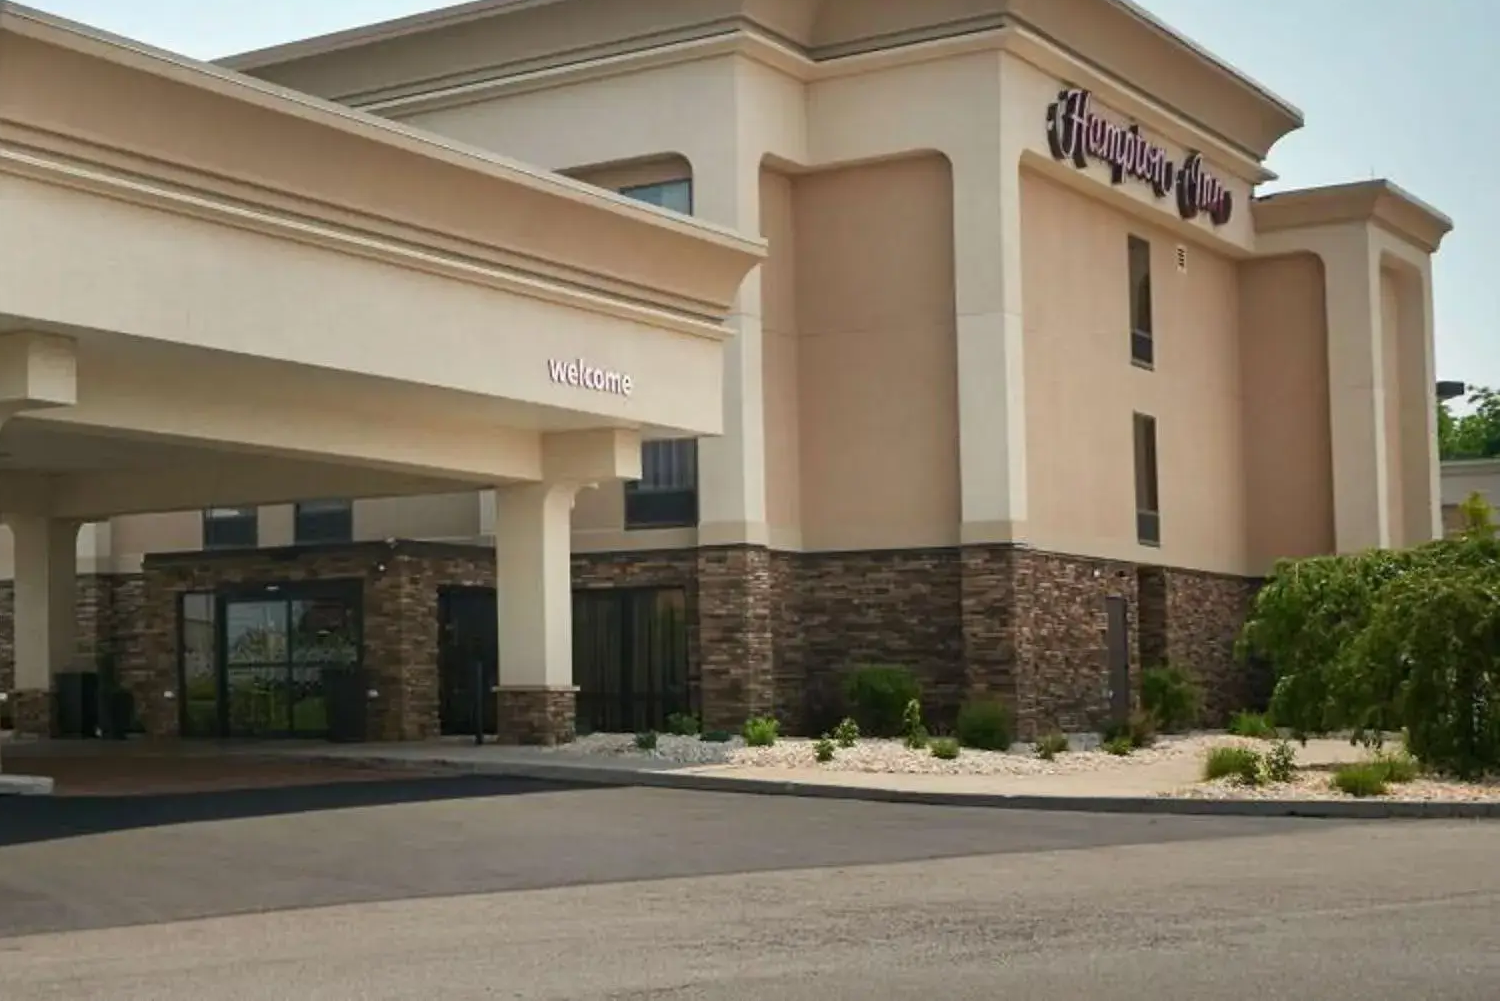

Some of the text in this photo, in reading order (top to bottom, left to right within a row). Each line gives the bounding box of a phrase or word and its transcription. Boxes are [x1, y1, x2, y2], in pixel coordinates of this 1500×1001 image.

[1047, 87, 1232, 226] Hampton Inn
[547, 358, 632, 396] welcome
